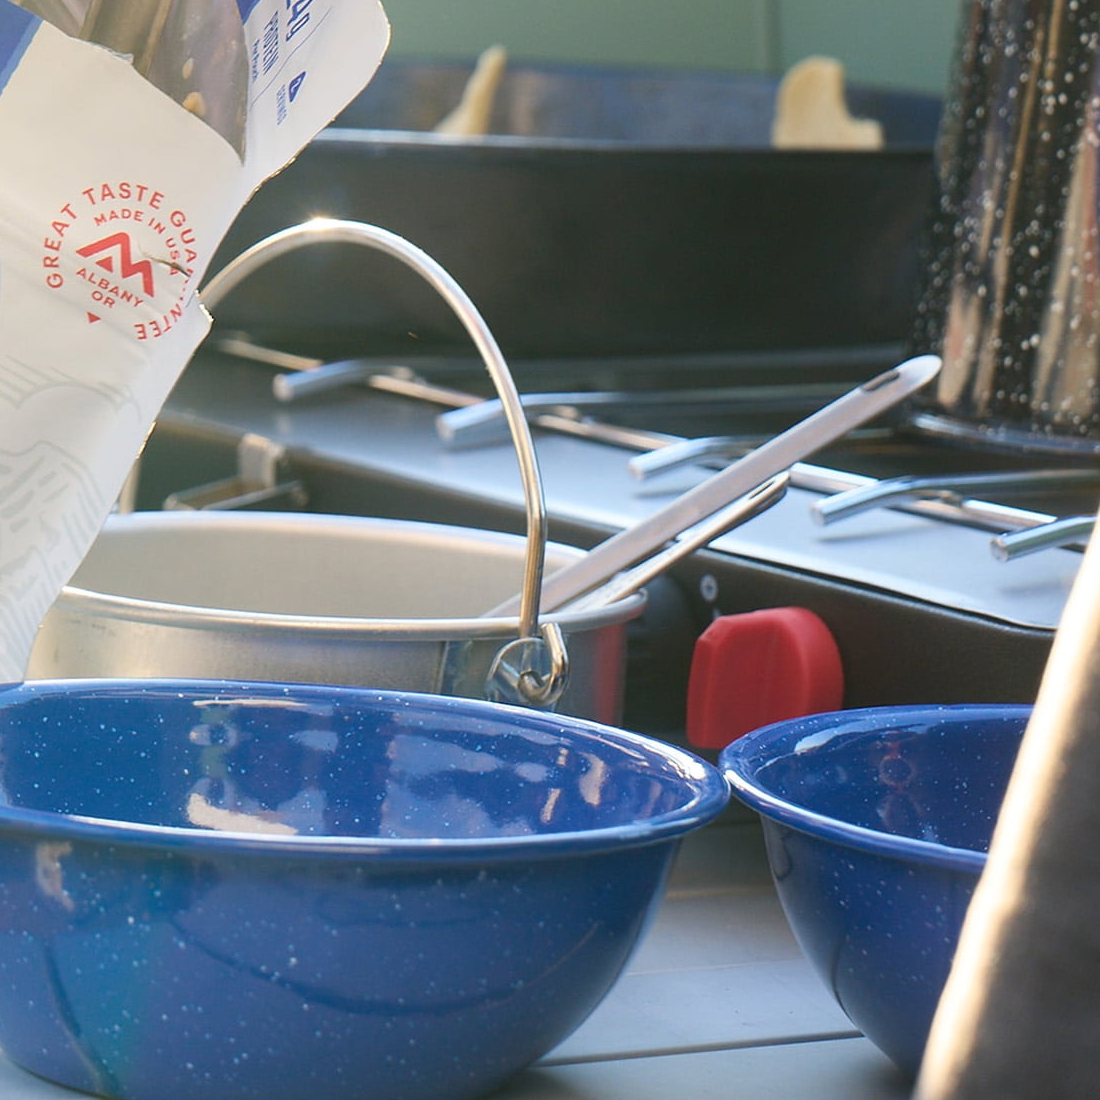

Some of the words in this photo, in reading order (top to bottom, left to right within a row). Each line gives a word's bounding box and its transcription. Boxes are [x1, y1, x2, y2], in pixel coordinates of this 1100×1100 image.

[93, 208, 144, 227] MADE
[148, 218, 167, 235] IN
[42, 203, 78, 289] GREAT
[82, 182, 164, 210] TASTE
[134, 210, 197, 340] GUANTEE
[76, 267, 144, 308] ALBANY
[91, 290, 116, 309] OR
